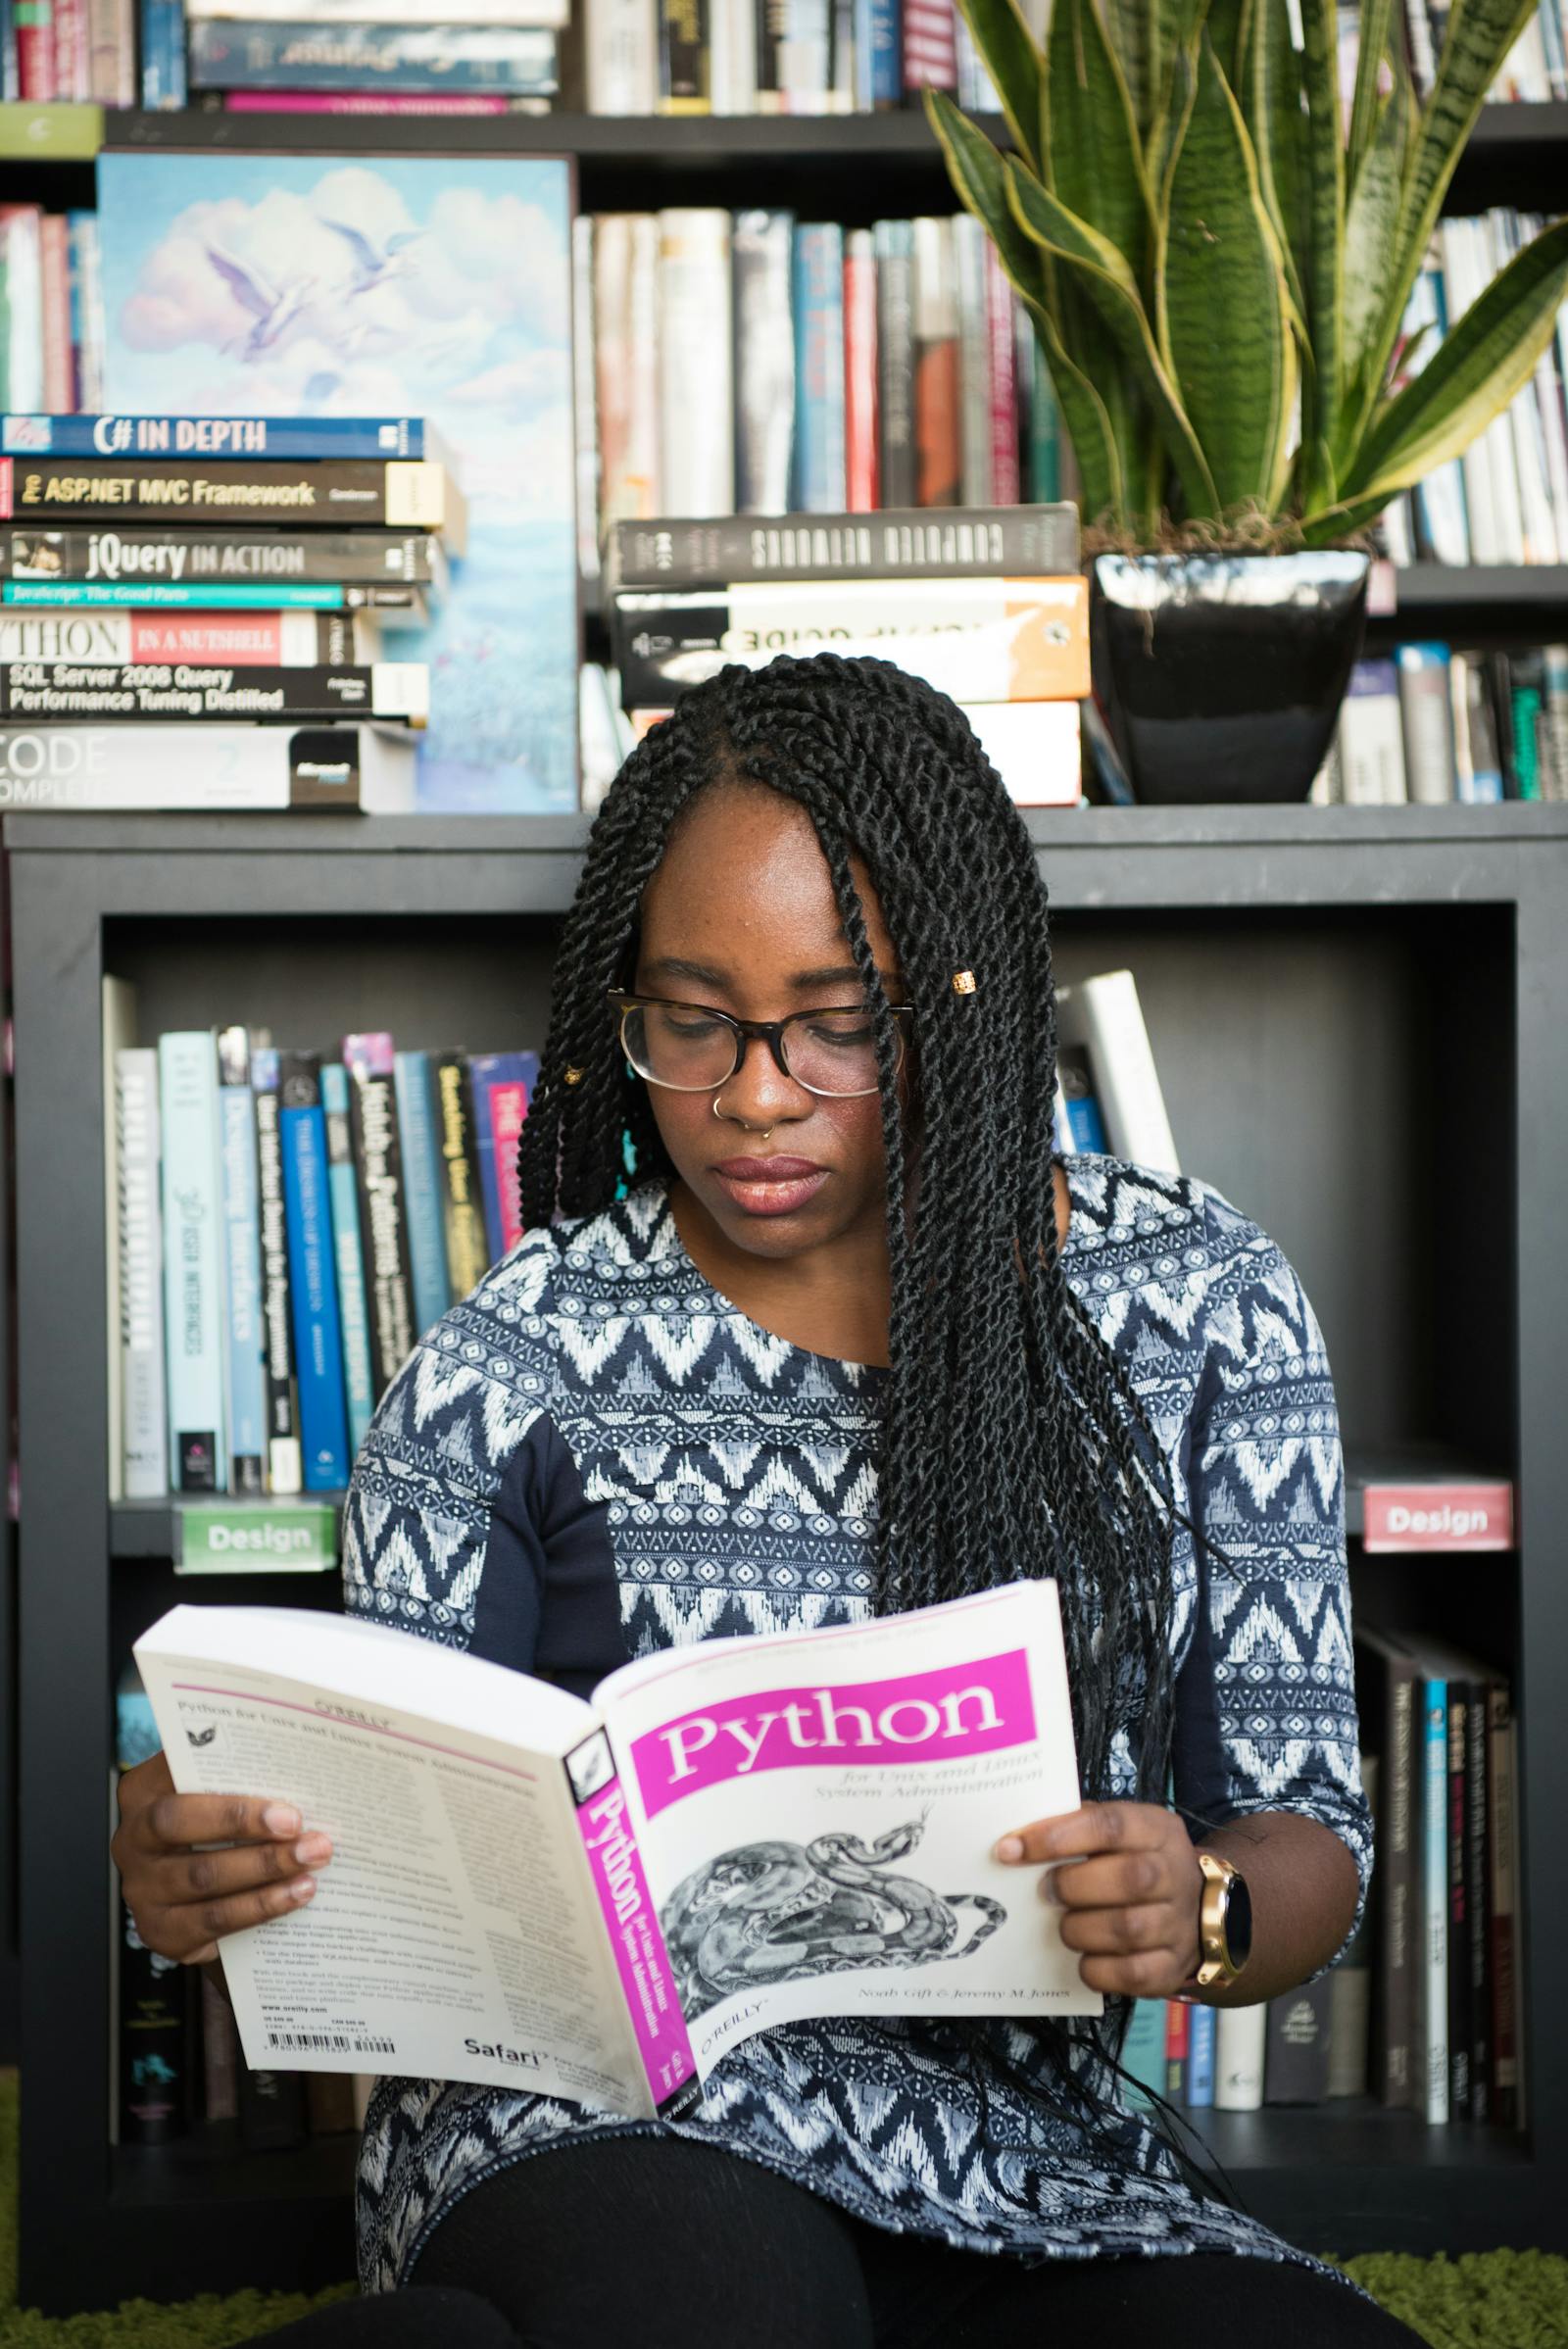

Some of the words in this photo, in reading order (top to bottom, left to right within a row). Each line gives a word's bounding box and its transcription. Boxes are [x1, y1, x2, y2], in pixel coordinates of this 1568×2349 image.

[93, 416, 133, 455] C#
[137, 419, 170, 451] IN
[176, 419, 267, 452] DEPTH
[44, 477, 135, 504] ASP.NET
[138, 478, 189, 505] MVC
[192, 480, 316, 506] Framework
[85, 533, 187, 580] jQuery
[192, 545, 218, 571] IN
[221, 545, 306, 574] ACTION
[9, 663, 50, 686] SQL
[53, 664, 120, 686] Server
[122, 664, 172, 687] 2008
[174, 664, 234, 692] Query
[9, 687, 135, 710] Performance
[136, 687, 203, 714] Tuning
[205, 688, 284, 711] Distilled
[0, 734, 108, 777] ODE
[258, 1096, 280, 1131] User
[438, 1065, 466, 1157] Sketching
[496, 1090, 520, 1137] THE
[222, 1096, 253, 1219] Designing
[260, 1132, 282, 1199] Interface
[448, 1158, 470, 1202] User
[262, 1200, 284, 1251] Design
[367, 1177, 400, 1275] Patterns
[232, 1224, 255, 1342] Interfaces
[267, 1253, 286, 1277] for
[265, 1278, 289, 1380] Programmers
[208, 1524, 312, 1554] Design
[1388, 1507, 1488, 1537] Design
[177, 1700, 232, 1717] Python
[235, 1708, 256, 1722] for
[261, 1713, 296, 1730] Unix
[302, 1722, 326, 1737] and
[330, 1728, 372, 1750] Linux
[314, 1697, 390, 1731] O'REILLY
[658, 1685, 1005, 1786] Python
[815, 1786, 882, 1800] System
[892, 1768, 1044, 1798] Administration
[841, 1771, 870, 1786] for
[879, 1769, 928, 1784] Unix
[934, 1763, 977, 1780] and
[985, 1750, 1042, 1773] Linux
[586, 1787, 642, 1926] Python
[633, 1914, 648, 1933] for
[641, 1932, 656, 1960] Unix
[619, 1924, 640, 1965] System
[632, 1963, 661, 2039] Administration
[648, 1960, 662, 1982] and
[261, 2005, 328, 2014] www.oreilly.com
[654, 1982, 668, 2014] Linux
[858, 1988, 899, 1999] Noah
[904, 1988, 932, 1999] Gift
[937, 1989, 950, 1999] &
[952, 1988, 1005, 2000] Jeremy
[1028, 1988, 1071, 2000] Jones
[701, 2000, 764, 2056] O'REILLY
[465, 2038, 539, 2066] Safari
